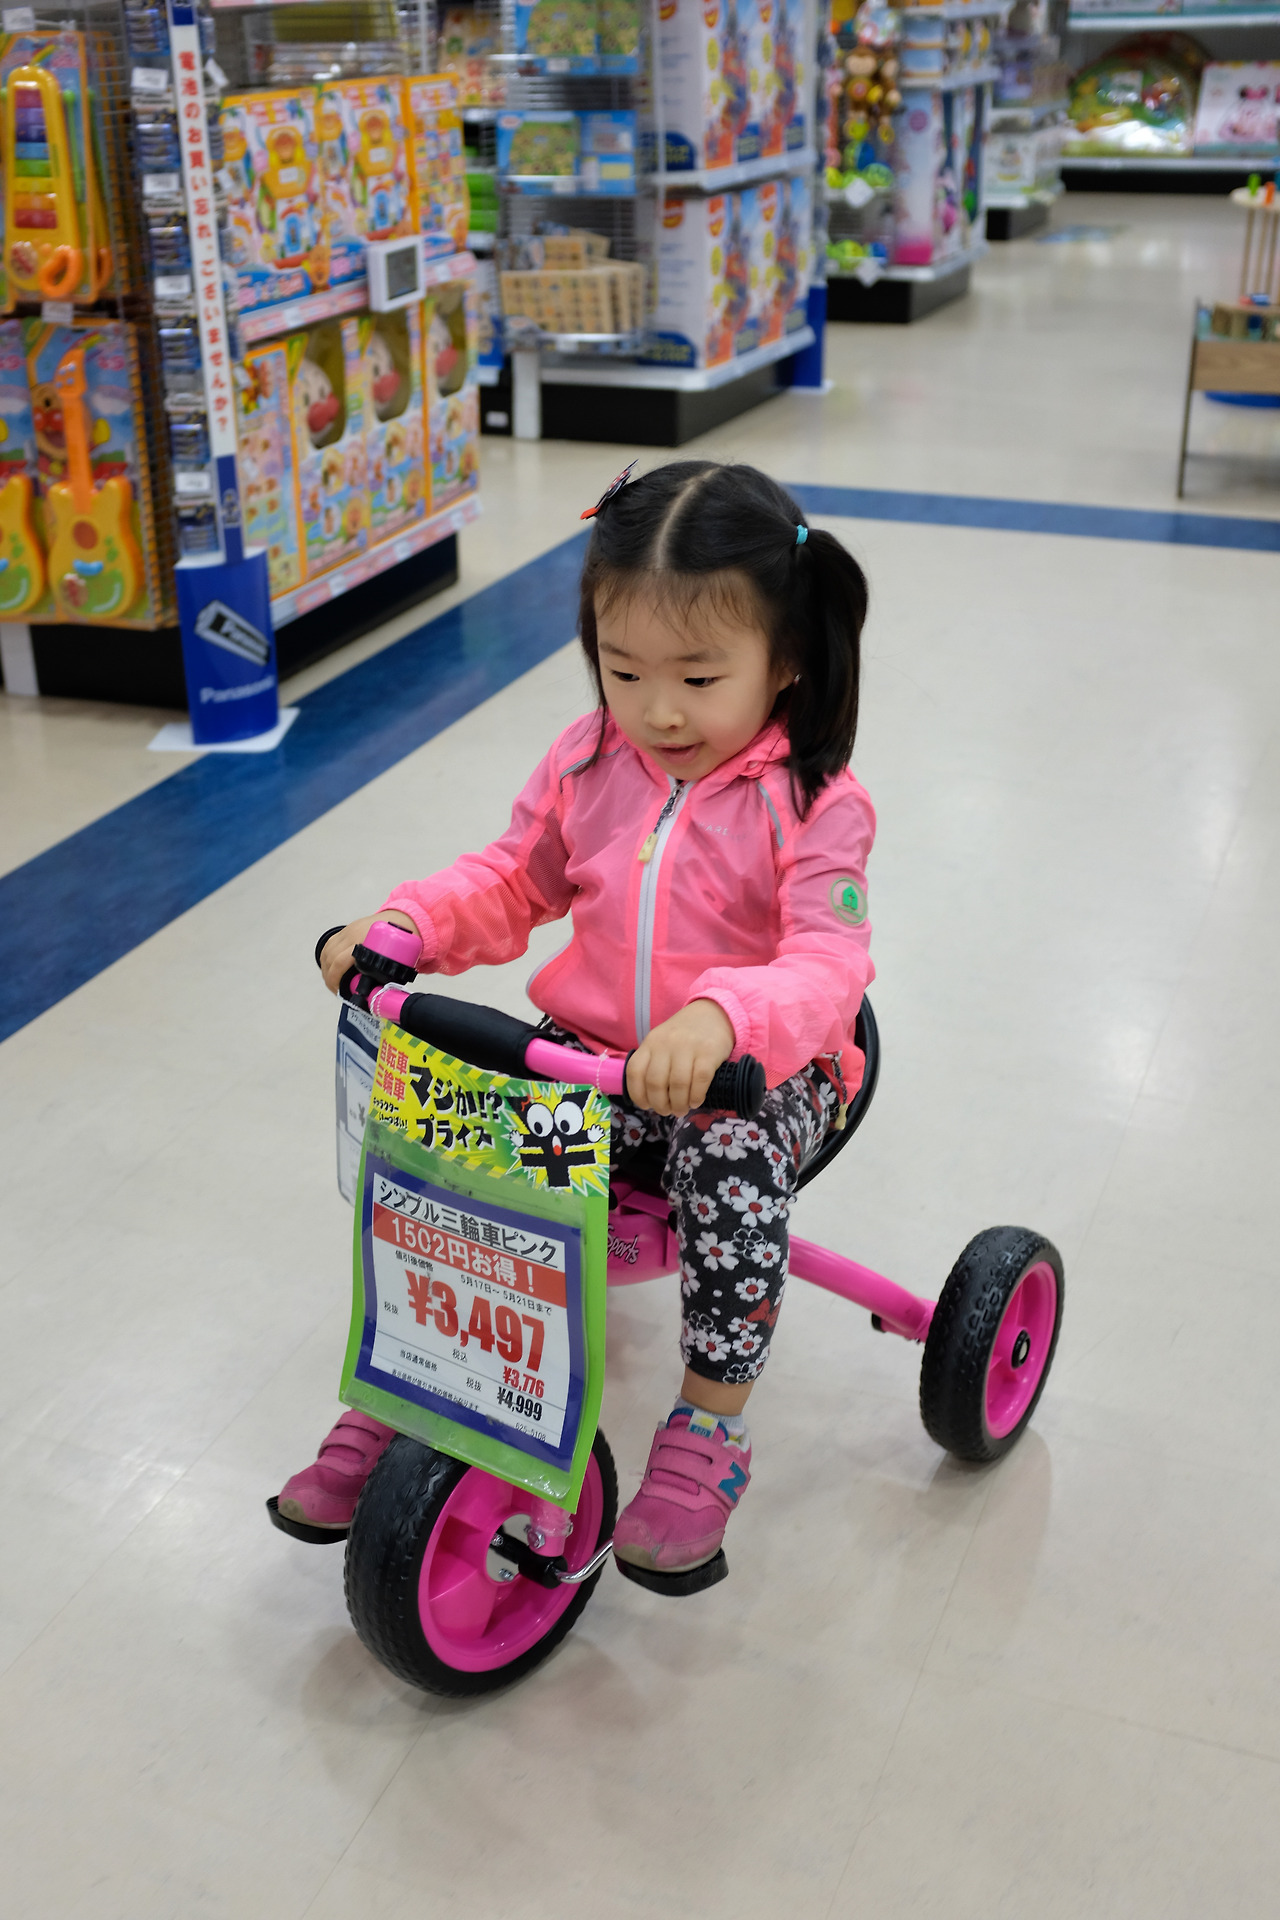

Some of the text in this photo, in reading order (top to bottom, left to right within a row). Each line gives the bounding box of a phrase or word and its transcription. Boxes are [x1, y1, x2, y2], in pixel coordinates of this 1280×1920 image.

[380, 1038, 409, 1075] 自転車
[376, 1063, 406, 1101] 三輪車
[416, 1113, 493, 1149] プライス
[380, 1180, 557, 1264] シンプル三輪車ピンク
[392, 1217, 535, 1293] 1502円お得！
[384, 1301, 399, 1315] 税抜
[404, 1269, 545, 1372] ¥3,497
[452, 1348, 468, 1363] 税込
[465, 1376, 482, 1393] 税抜
[503, 1365, 545, 1399] ¥3,776
[496, 1386, 543, 1422] ¥4,999
